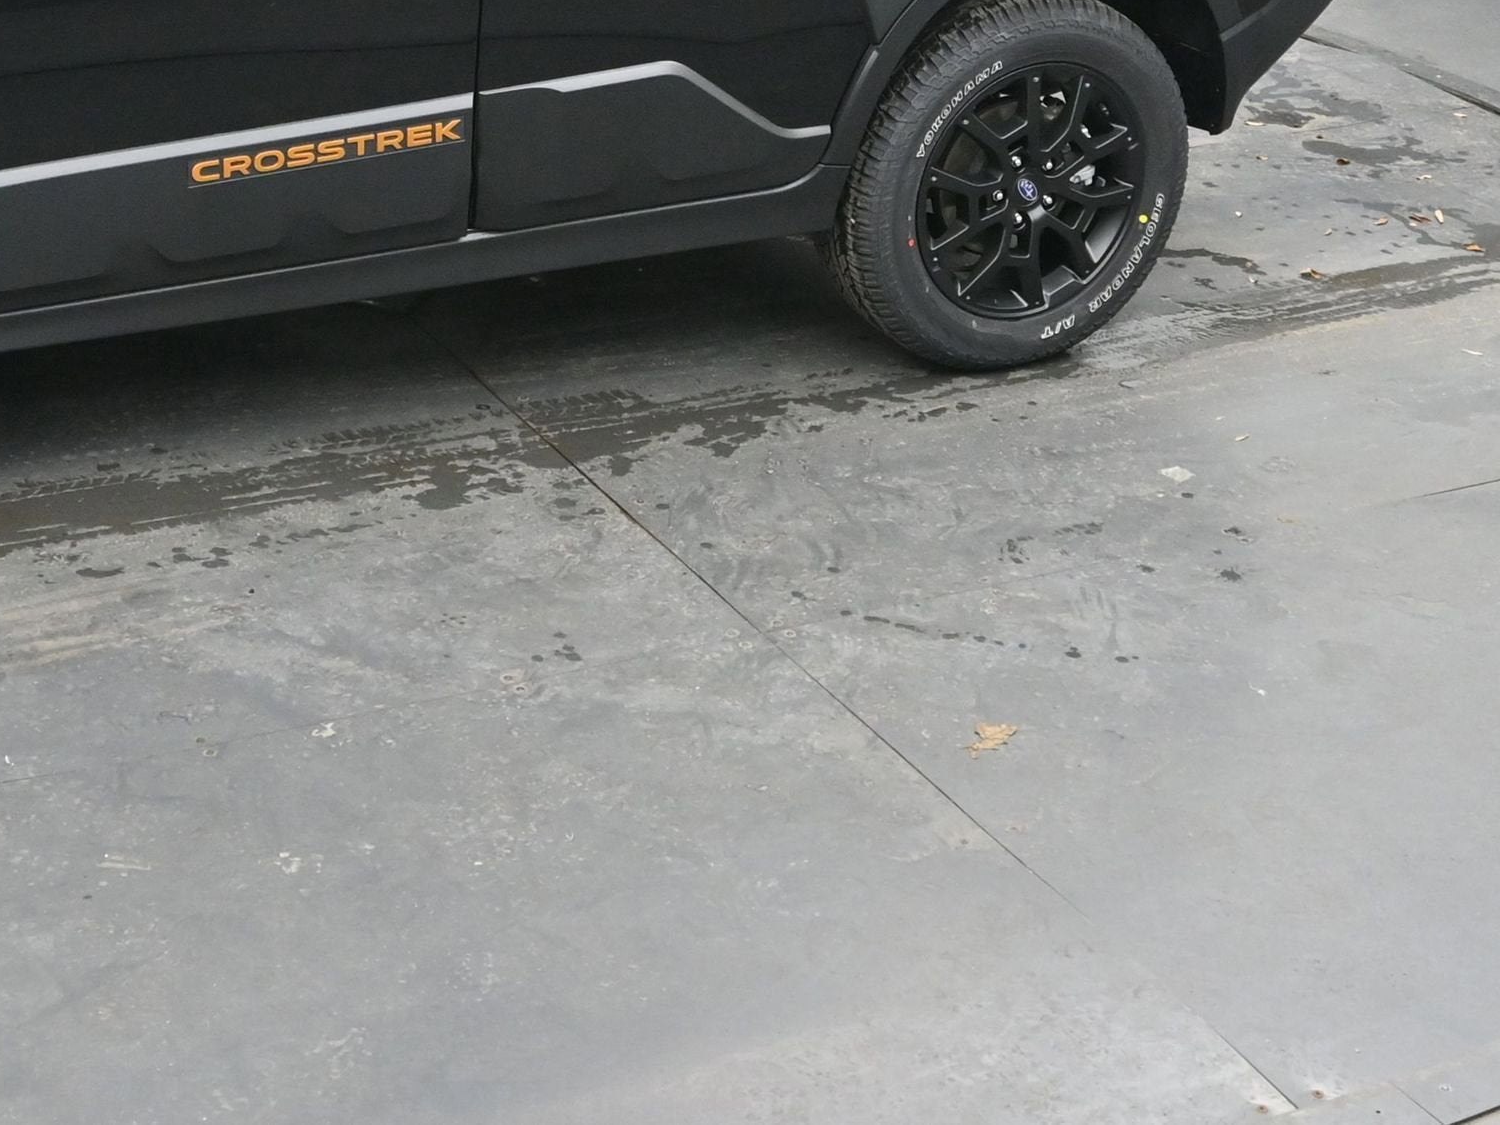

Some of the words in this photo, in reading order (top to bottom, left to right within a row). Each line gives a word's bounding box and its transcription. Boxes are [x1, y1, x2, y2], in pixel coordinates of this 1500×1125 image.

[916, 60, 1004, 159] YOKOHAMA
[191, 119, 463, 183] CROSSTREK
[1088, 193, 1165, 313] GEOLANDAR
[1040, 314, 1076, 340] A/T
